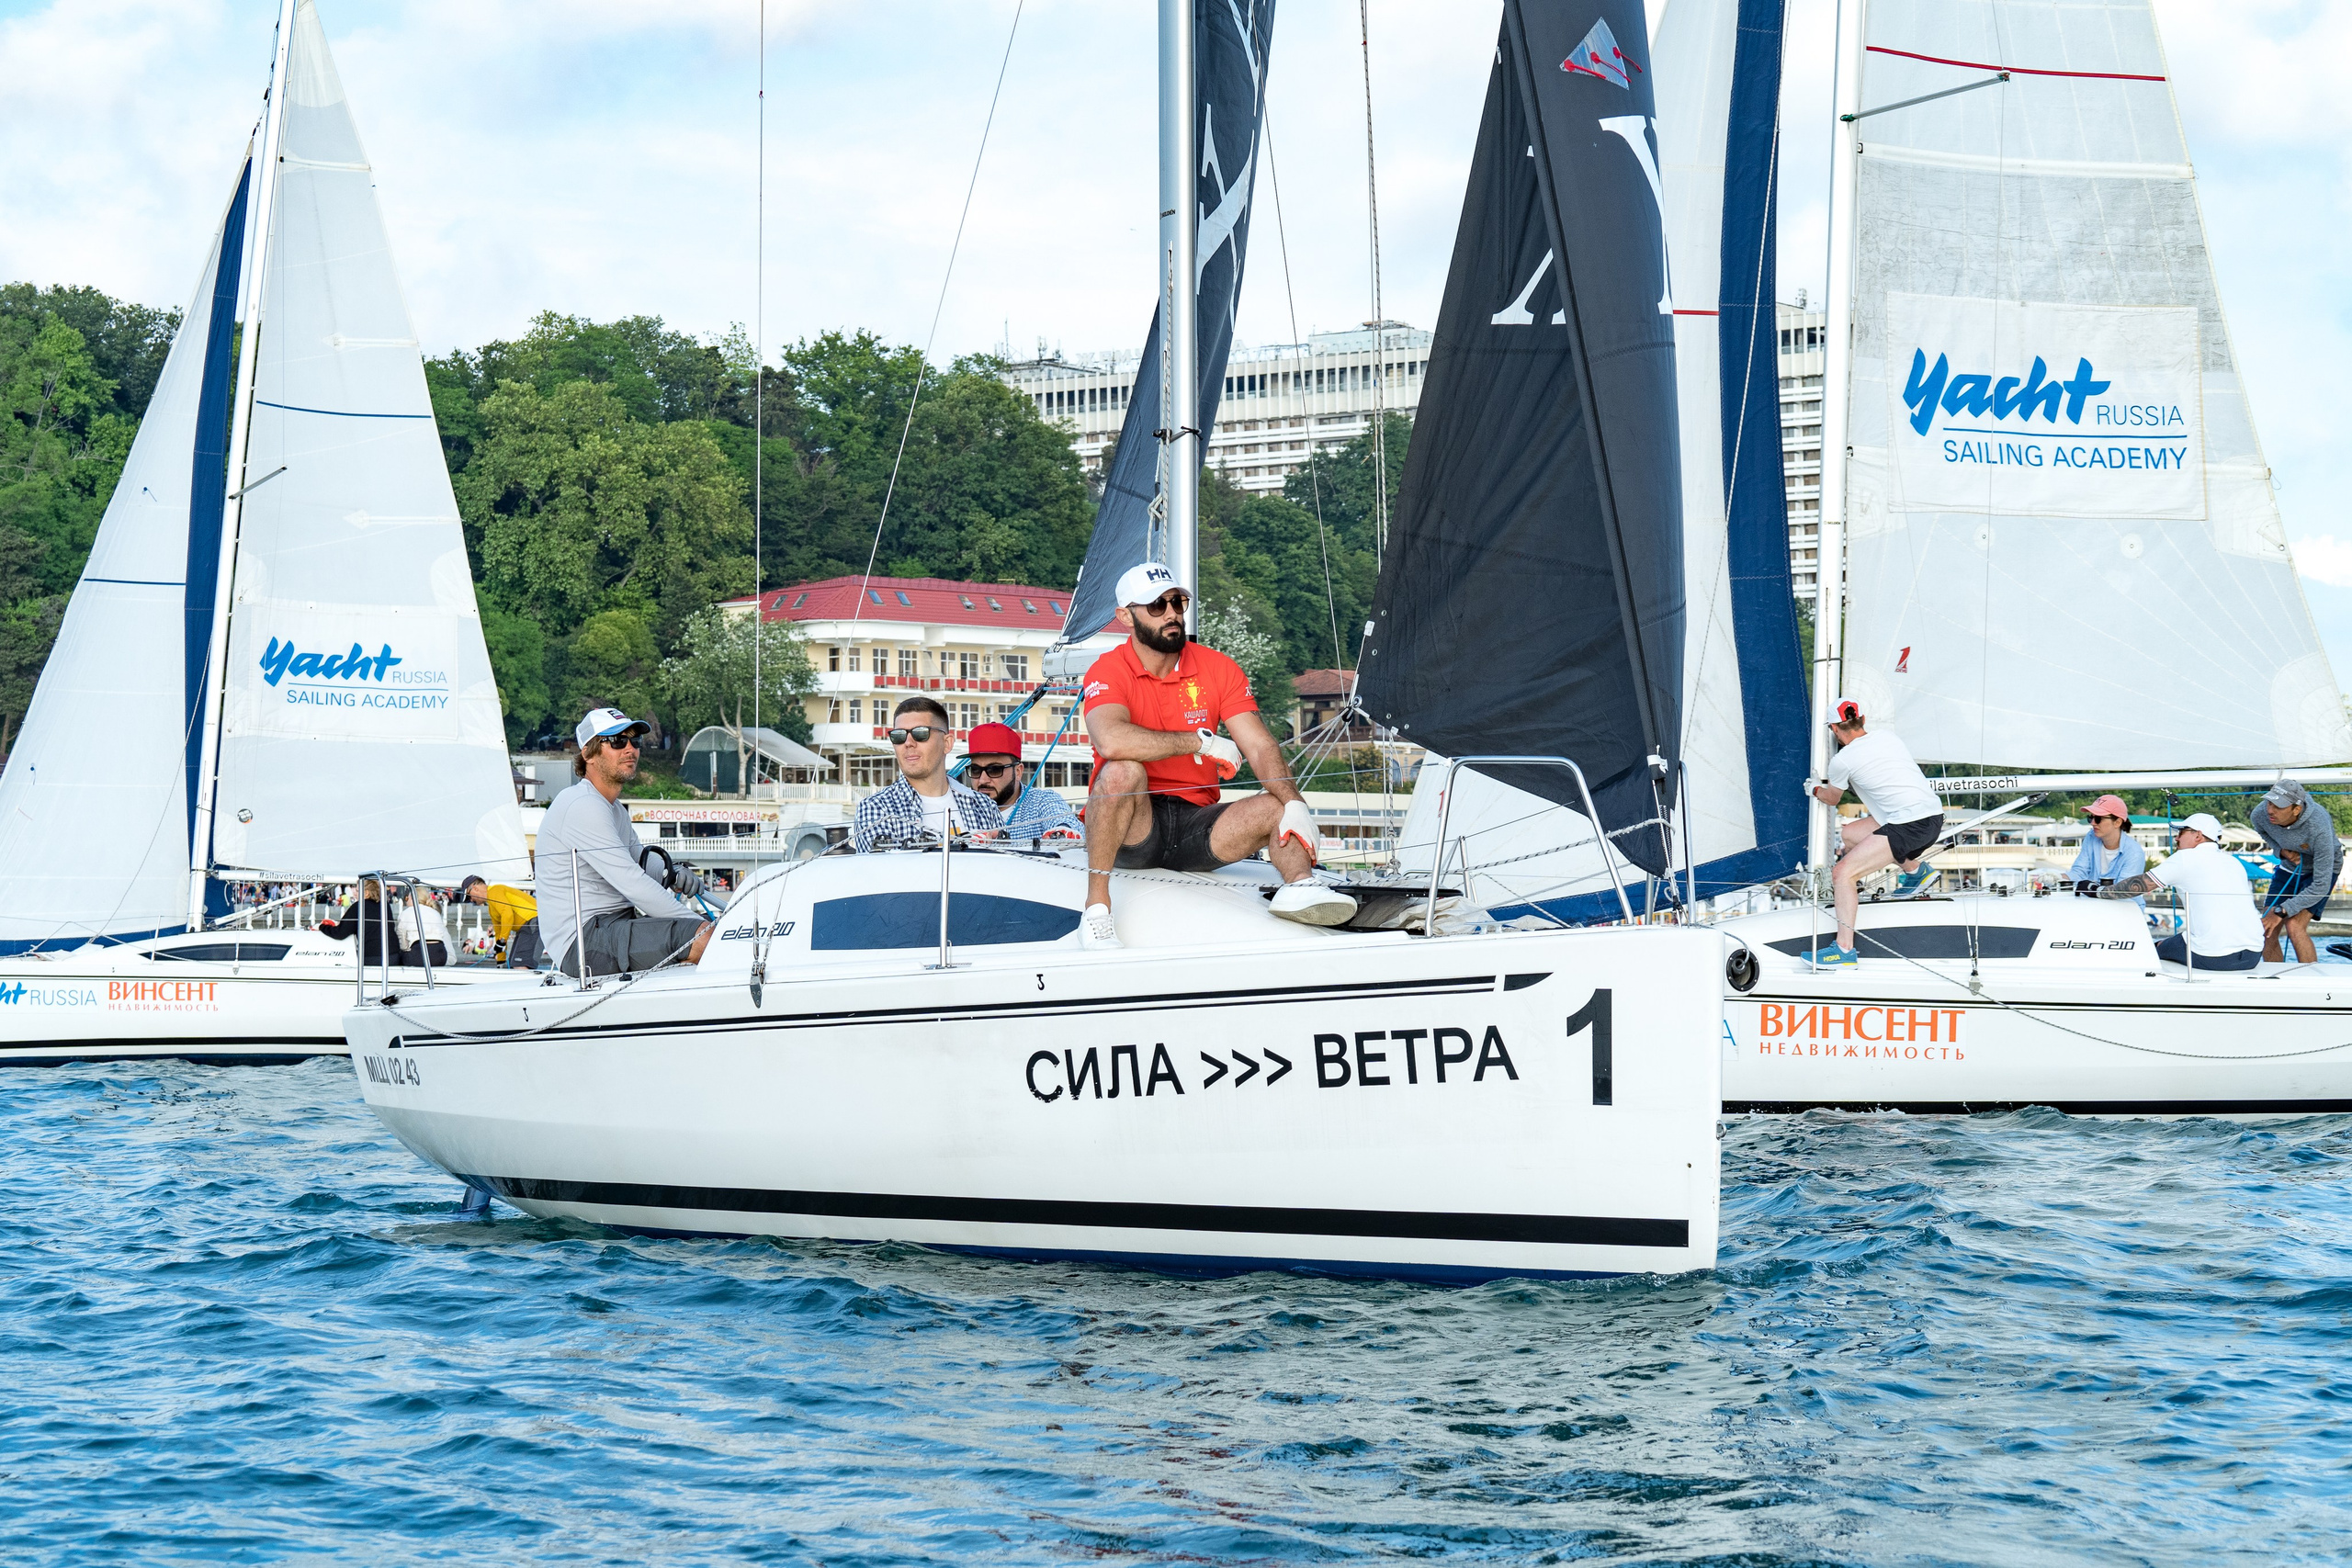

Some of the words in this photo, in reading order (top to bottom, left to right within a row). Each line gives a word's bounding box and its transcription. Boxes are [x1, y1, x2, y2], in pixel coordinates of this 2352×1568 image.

[2097, 404, 2185, 426] RUSSIA
[1943, 439, 2043, 468] SAILING
[2053, 446, 2188, 470] ACADEMY
[1146, 568, 1172, 581] HH
[392, 671, 448, 683] RUSSIA
[287, 690, 356, 706] SAILING
[361, 694, 448, 709] ACADEMY
[649, 809, 707, 821] ВОСТОЧНАЯ
[710, 810, 761, 821] СТОЛОВАЯ
[258, 872, 325, 882] #silavetrasochi
[720, 925, 768, 941] elan
[2050, 940, 2105, 950] elan
[2108, 940, 2136, 951] 210
[1823, 953, 1841, 963] HOKA
[30, 989, 97, 1006] RUSSIA
[108, 981, 219, 1001] ВИНСЕНТ
[108, 1003, 219, 1012] НЕДВИЖИМОСТЬ
[1759, 1003, 1966, 1043] ВИНСЕНТ
[1566, 987, 1613, 1107] 1
[1759, 1042, 1965, 1061] НЕДВИЖИМОСТЬ
[388, 1057, 406, 1085] 02
[405, 1057, 421, 1087] 43
[1025, 1042, 1185, 1103] СИЛА
[1313, 1025, 1520, 1089] ВЕТРА
